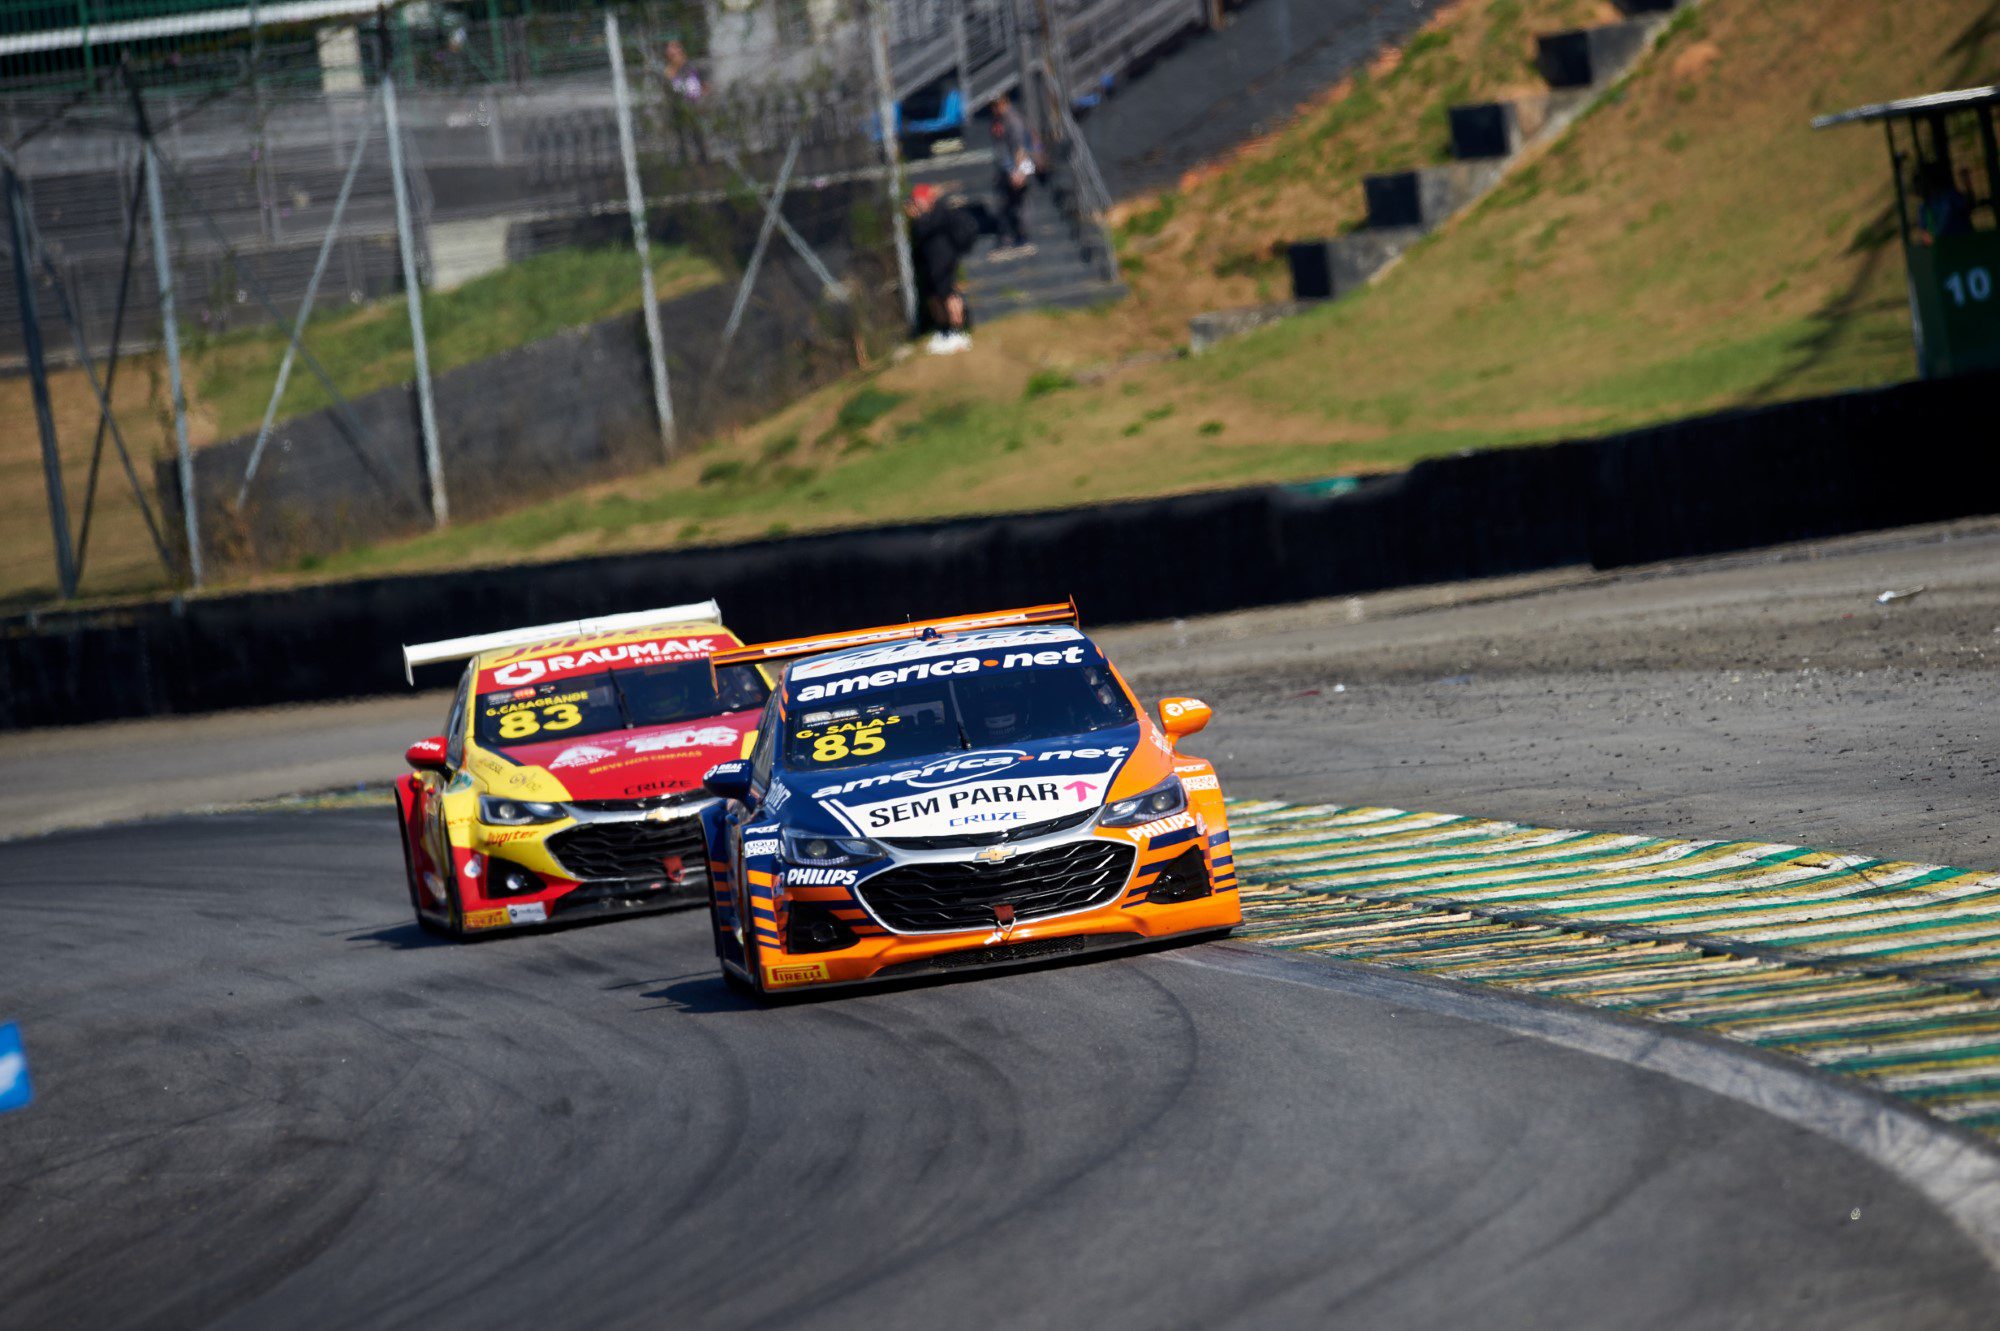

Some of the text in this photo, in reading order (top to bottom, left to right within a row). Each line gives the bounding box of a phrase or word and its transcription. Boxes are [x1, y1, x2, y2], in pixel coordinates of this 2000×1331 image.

[1944, 268, 1991, 306] 10
[549, 638, 714, 671] RAUMAK
[633, 651, 710, 665] PACKAGIN
[499, 703, 582, 739] 83
[796, 730, 820, 739] G.
[826, 715, 901, 735] SALAS
[812, 726, 886, 762] 85
[624, 778, 693, 796] CRUZE
[869, 782, 1060, 828] SEM PARAR
[949, 810, 1027, 828] CRUZE
[1127, 811, 1196, 842] PHILIPS
[787, 869, 859, 886] PHILIPS
[772, 965, 822, 981] PIRELLI
